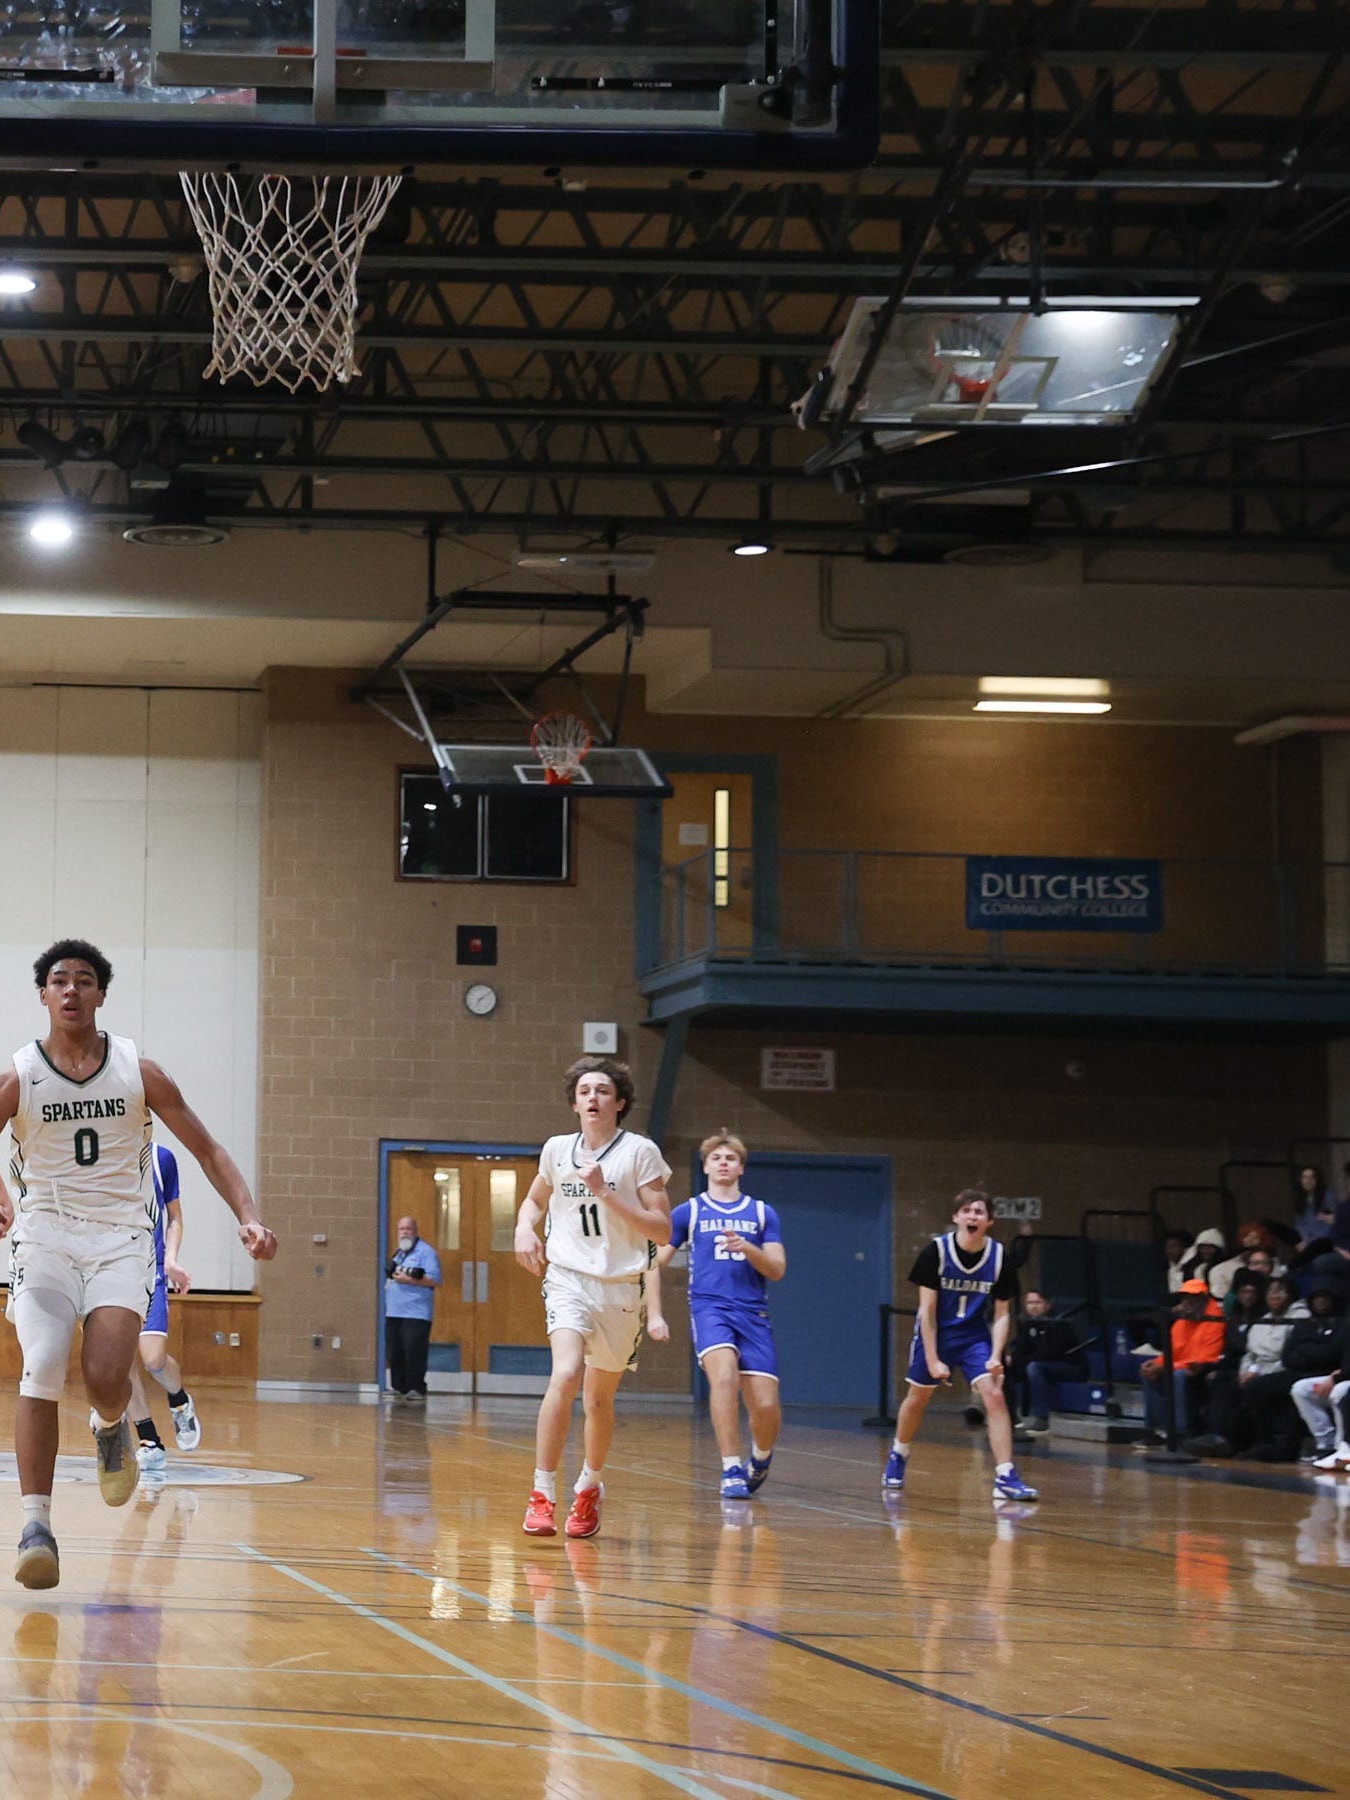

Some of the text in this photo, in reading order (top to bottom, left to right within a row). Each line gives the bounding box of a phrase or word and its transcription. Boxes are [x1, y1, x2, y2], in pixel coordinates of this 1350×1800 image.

[981, 873, 1150, 900] DUTCHESS
[980, 903, 1148, 917] COMMUNITY COLLEGE
[42, 1098, 125, 1122] SPARTANS
[74, 1128, 99, 1166] 0
[579, 1204, 602, 1236] 11
[699, 1218, 758, 1235] HALDANE
[956, 1295, 968, 1318] 1
